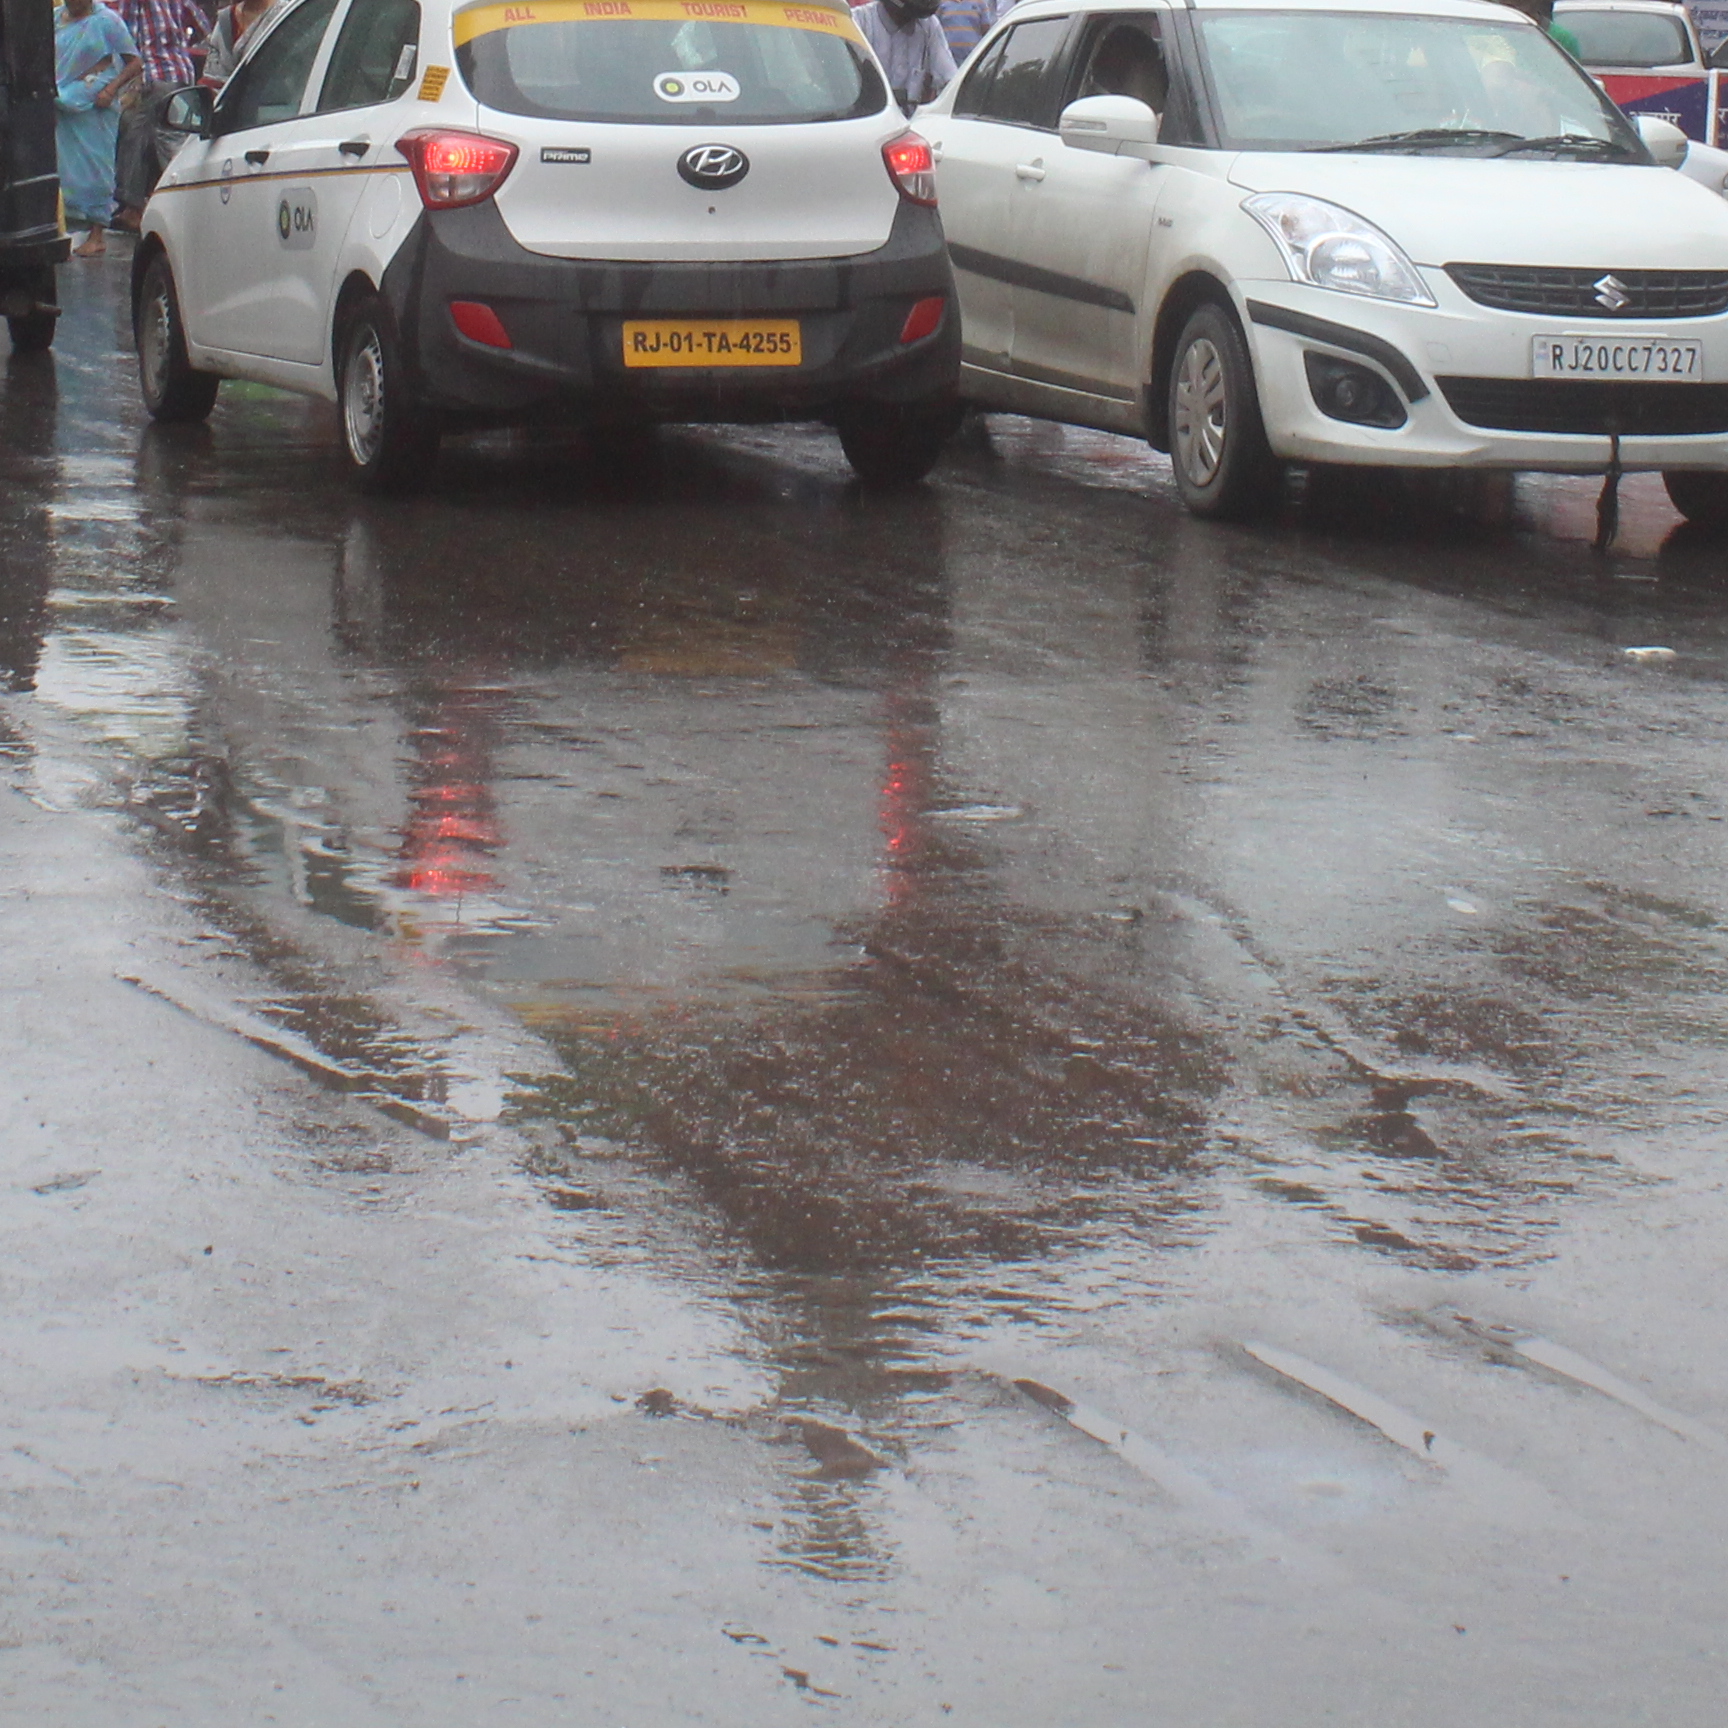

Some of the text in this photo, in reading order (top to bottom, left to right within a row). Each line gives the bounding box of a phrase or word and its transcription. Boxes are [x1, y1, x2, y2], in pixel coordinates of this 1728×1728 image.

[504, 2, 838, 29] ALL INDIA TOURIST PERMIT
[693, 80, 733, 93] OLA
[633, 331, 792, 353] RJ-01-TA-4255
[1550, 344, 1697, 374] RJ20CC7327
